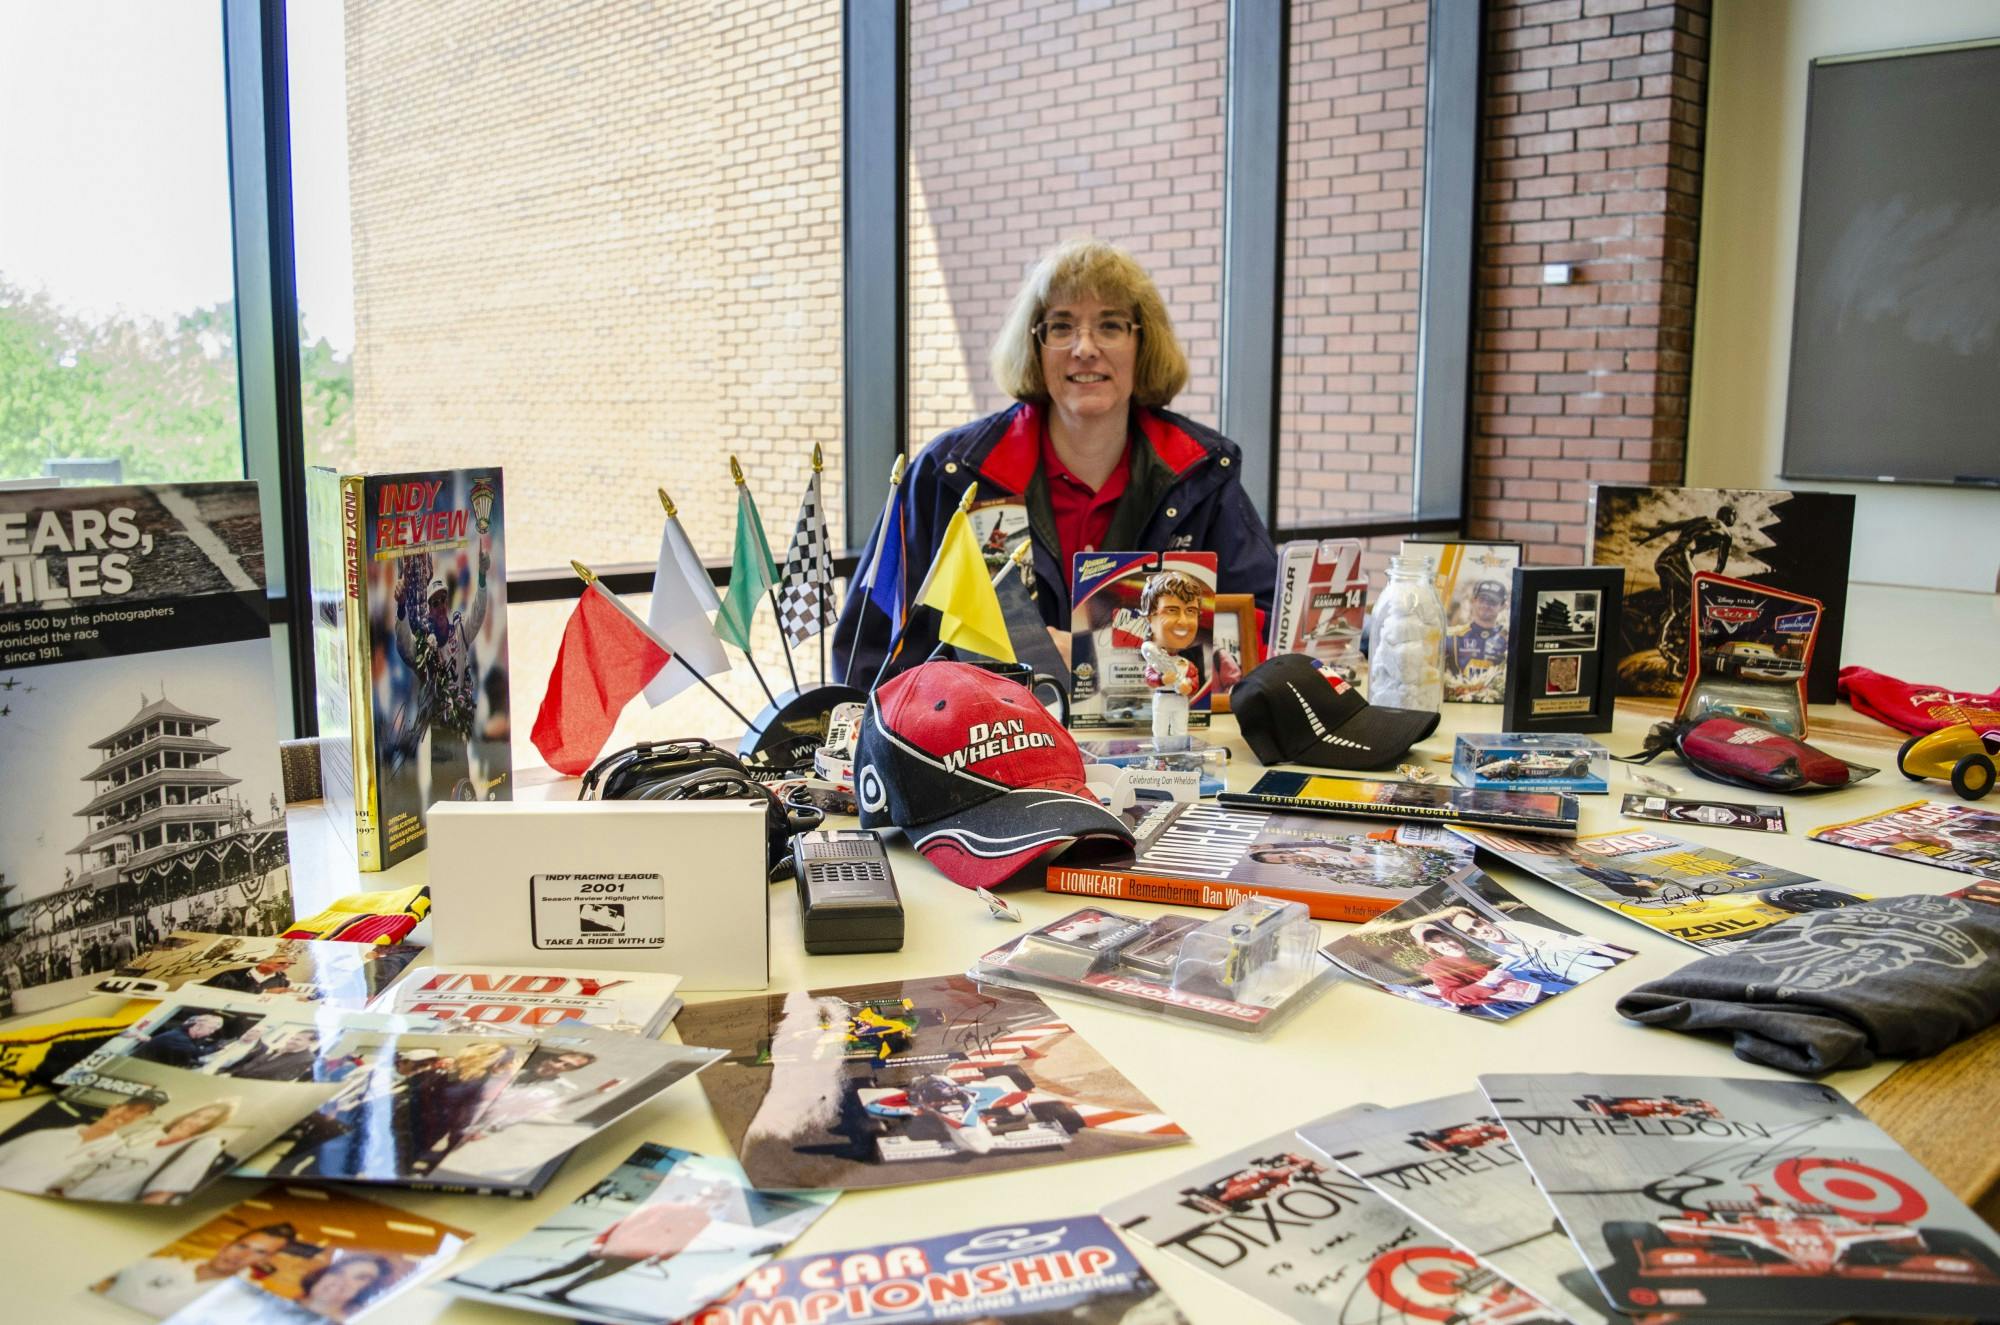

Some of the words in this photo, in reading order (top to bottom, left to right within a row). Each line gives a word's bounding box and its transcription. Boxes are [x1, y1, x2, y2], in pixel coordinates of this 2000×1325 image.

[345, 491, 357, 527] INDY
[379, 479, 443, 516] INDY
[376, 510, 470, 550] REVIEW
[347, 537, 359, 600] REVIEW
[1278, 566, 1296, 650] INDYCAR
[1313, 598, 1342, 608] KANAAN
[1345, 589, 1361, 608] 14
[24, 619, 49, 630] 500
[52, 617, 67, 629] by
[71, 614, 90, 625] the
[93, 607, 175, 624] photographers
[52, 631, 71, 642] the
[74, 630, 99, 640] race
[5, 649, 36, 664] since
[968, 719, 1024, 746] DAN
[943, 732, 1055, 774] WHELDON
[1129, 775, 1160, 787] Celebrating
[1162, 776, 1173, 785] Dan
[1173, 776, 1197, 785] Wheldon
[1284, 798, 1349, 809] INDIANAPOLIS
[1370, 805, 1412, 814] OFFICIAL
[1414, 807, 1459, 817] PROGRAM
[1834, 817, 1902, 842] INDY
[1895, 804, 1963, 826] CAR
[1130, 803, 1272, 879] LIONHEART
[1576, 832, 1674, 855] CAR
[580, 884, 625, 893] 2001
[1060, 871, 1124, 897] LIONHEART
[1129, 879, 1199, 905] Remembering
[1202, 886, 1222, 905] Dan
[1088, 922, 1143, 951] INDYCAR
[1833, 912, 1969, 948] MOTOR
[416, 974, 634, 997] INDY
[464, 994, 546, 1003] American
[550, 997, 589, 1006] Icon
[1188, 995, 1260, 1018] auto
[409, 1003, 587, 1027] 500
[1504, 1115, 1772, 1140] WHELDON
[1157, 1171, 1372, 1269] DIXON
[800, 1247, 931, 1290] CAR
[934, 1294, 1014, 1318] RACING
[1020, 1272, 1130, 1304] MAGAZINE
